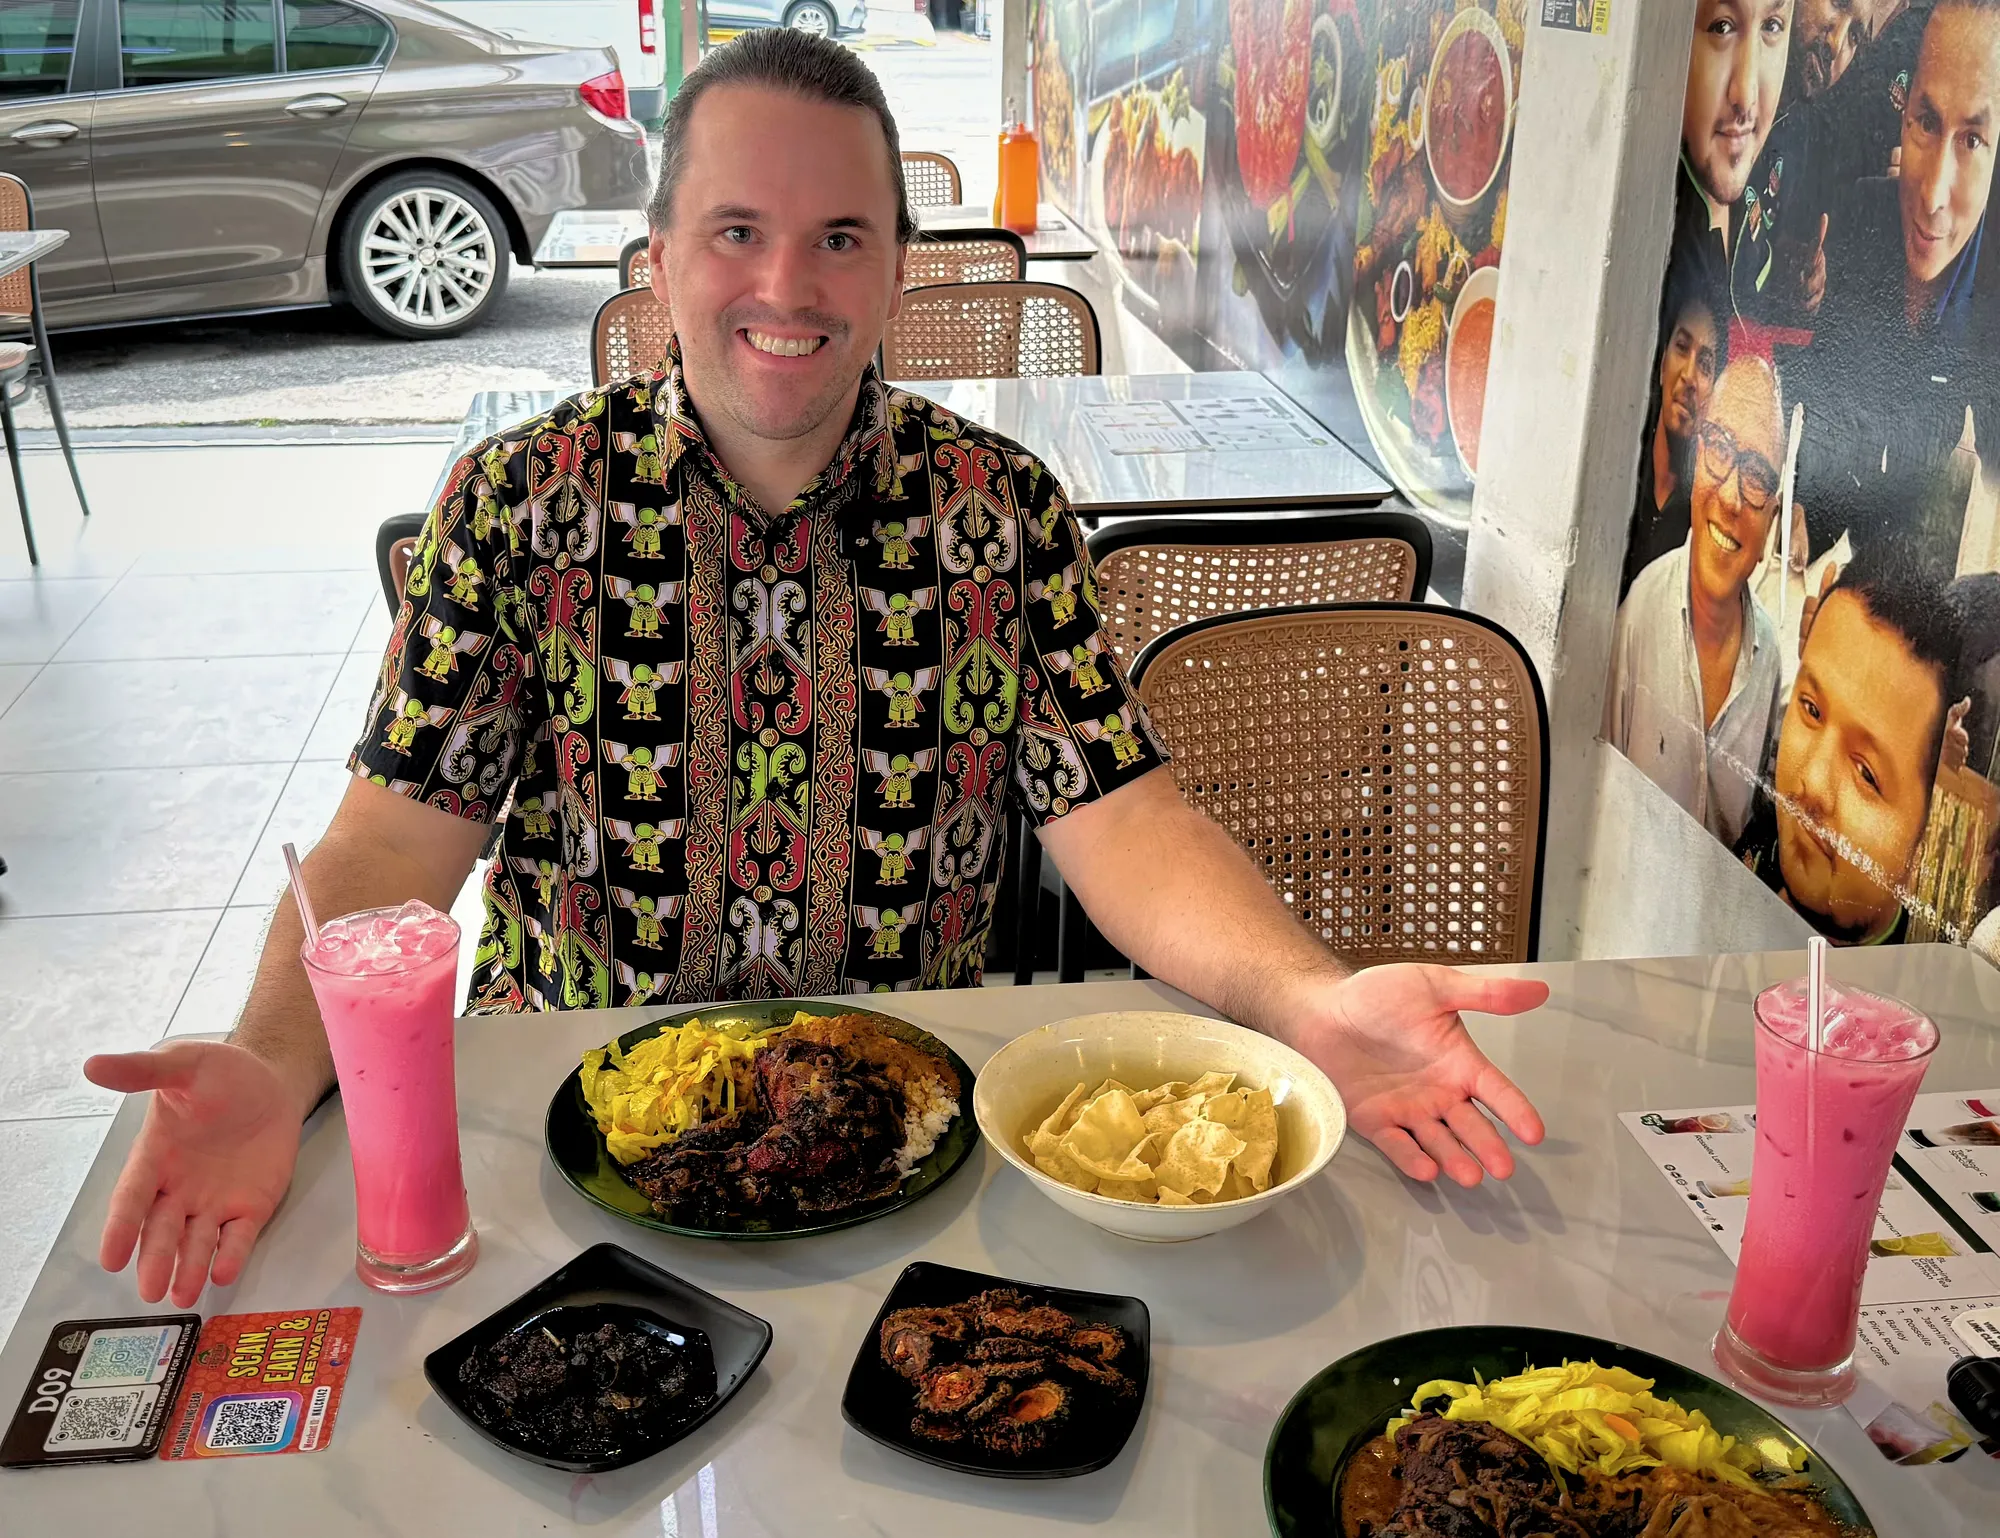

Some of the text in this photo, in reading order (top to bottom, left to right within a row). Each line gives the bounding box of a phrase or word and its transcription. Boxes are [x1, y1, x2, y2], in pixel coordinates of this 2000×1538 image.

[856, 537, 870, 547] dji
[1712, 1155, 1730, 1174] Lemon
[1911, 1258, 1934, 1280] Lemon
[1919, 1258, 1949, 1288] Green Tea
[1926, 1258, 1952, 1284] Jasmine
[179, 1323, 193, 1344] FUTURE
[1868, 1320, 1885, 1337] Pink
[1882, 1338, 1900, 1356] Rose
[1886, 1319, 1908, 1342] Barley
[1904, 1318, 1932, 1347] Rosselle
[1912, 1307, 1923, 1315] 6.
[1921, 1316, 1951, 1346] Jasmine
[1949, 1346, 1962, 1360] Gre
[1966, 1320, 2000, 1352] LINE CLEA
[175, 1345, 185, 1357] OUR
[227, 1326, 276, 1377] SCAN,
[262, 1316, 312, 1382] EARN &
[299, 1309, 331, 1384] REWARD
[1857, 1326, 1890, 1366] heat Grass
[170, 1358, 181, 1370] FOR
[26, 1366, 74, 1413] D09
[158, 1371, 176, 1406] EXPERIENCE
[139, 1401, 152, 1419] TikTok
[151, 1408, 163, 1424] YOUR
[143, 1426, 156, 1446] SHARE
[171, 1392, 204, 1456] NASI KANDAR LINE CLEAR
[302, 1425, 318, 1448] Merchant
